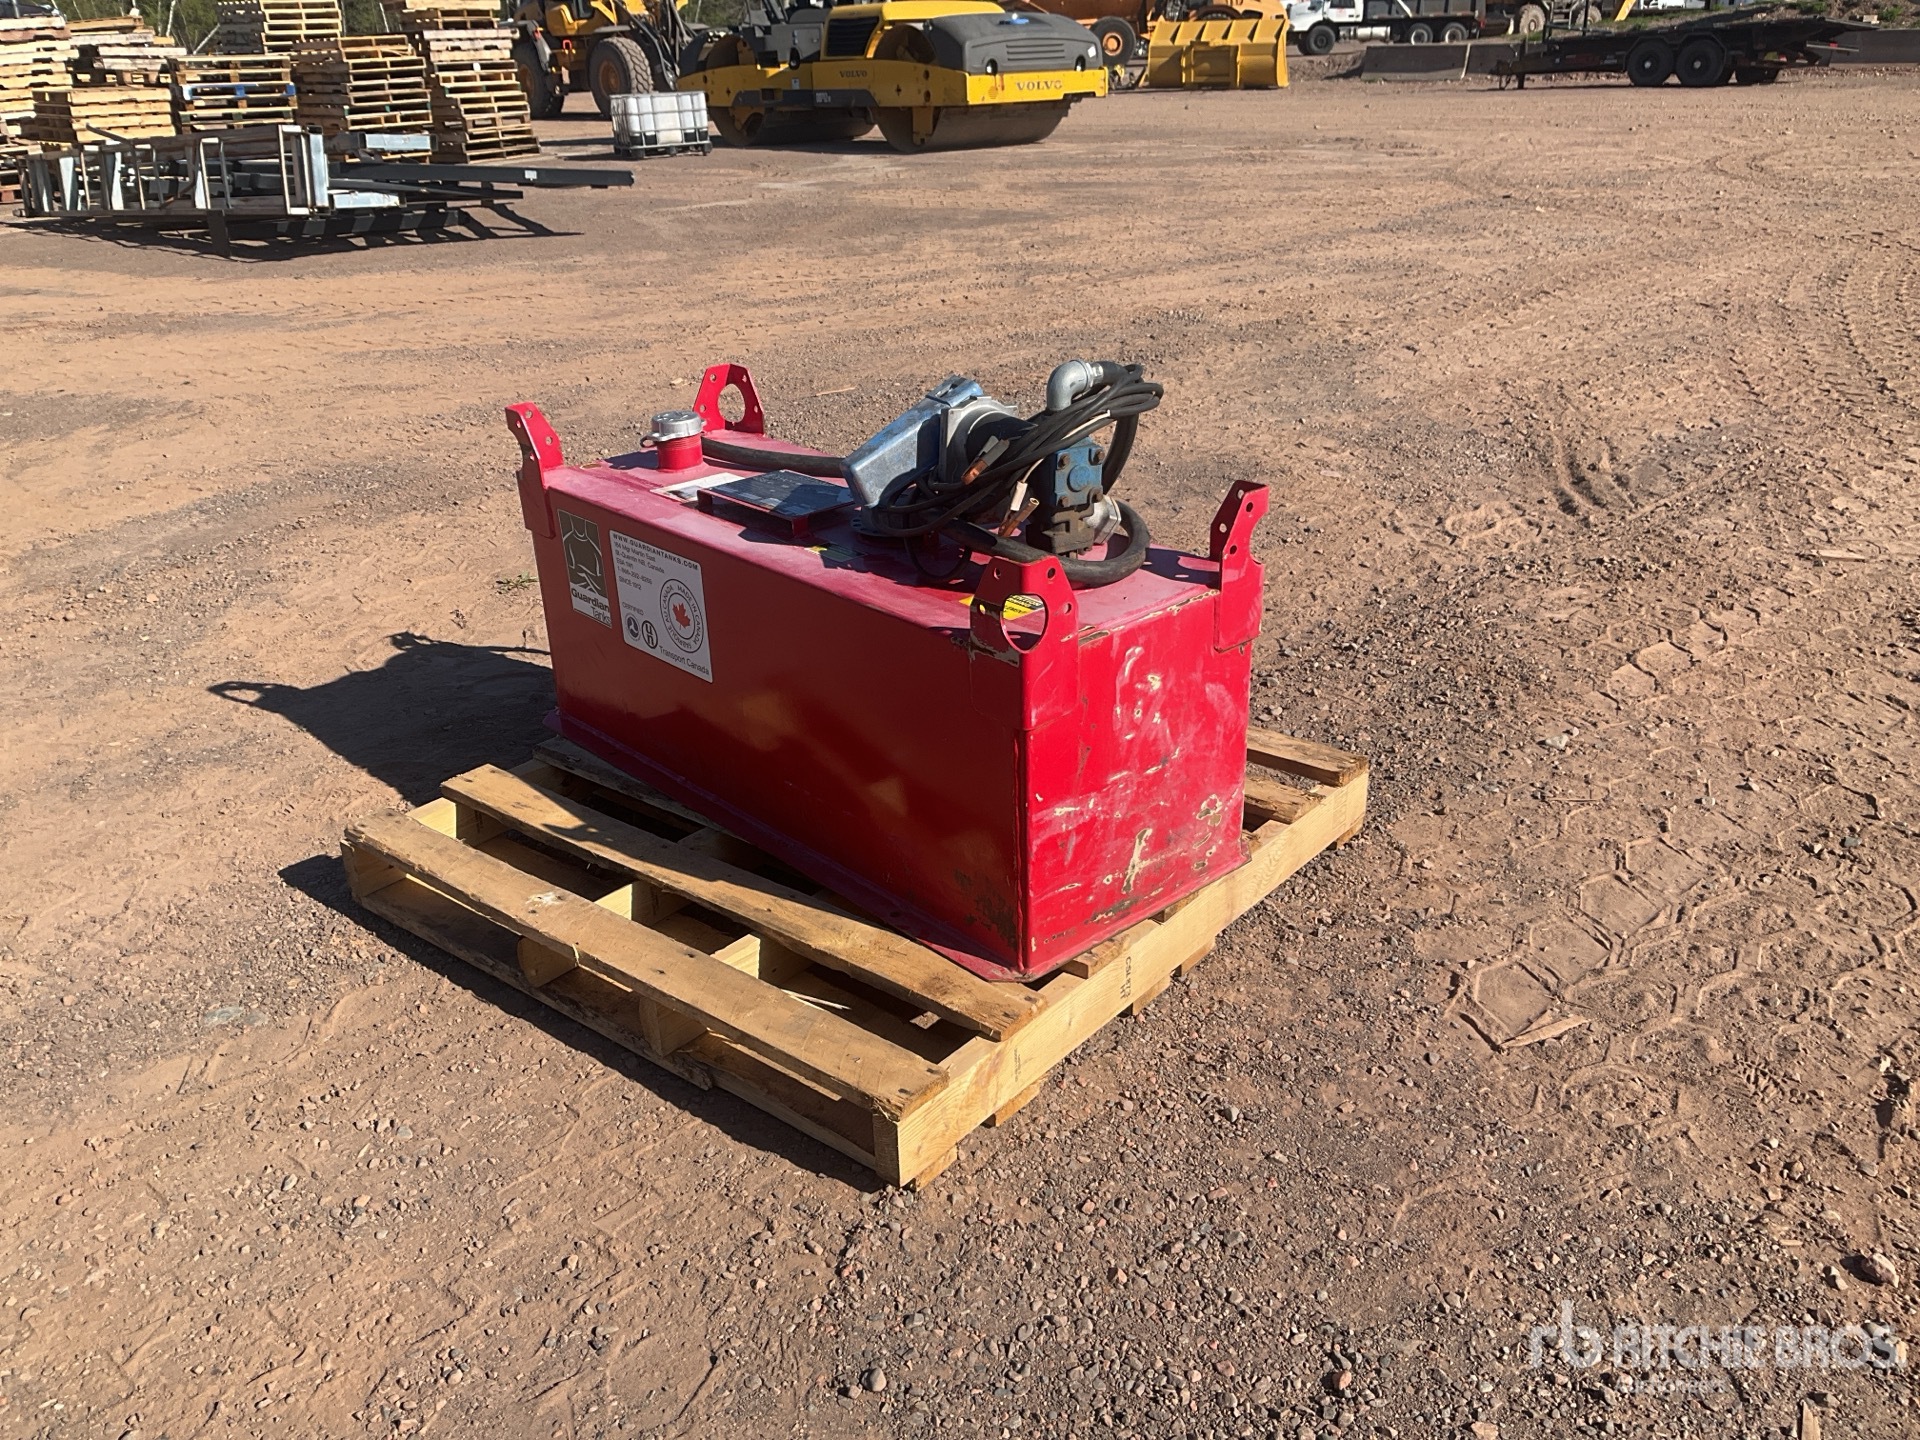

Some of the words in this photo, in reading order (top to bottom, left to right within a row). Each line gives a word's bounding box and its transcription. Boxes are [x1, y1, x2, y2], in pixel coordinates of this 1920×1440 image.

[839, 70, 868, 79] VOLVO
[1016, 80, 1063, 92] VOLVO
[571, 588, 610, 612] Guardian
[591, 606, 611, 624] Tanks
[677, 585, 692, 601] MADE
[693, 615, 701, 645] CANADA
[659, 646, 686, 665] Transport
[687, 658, 710, 676] Canada
